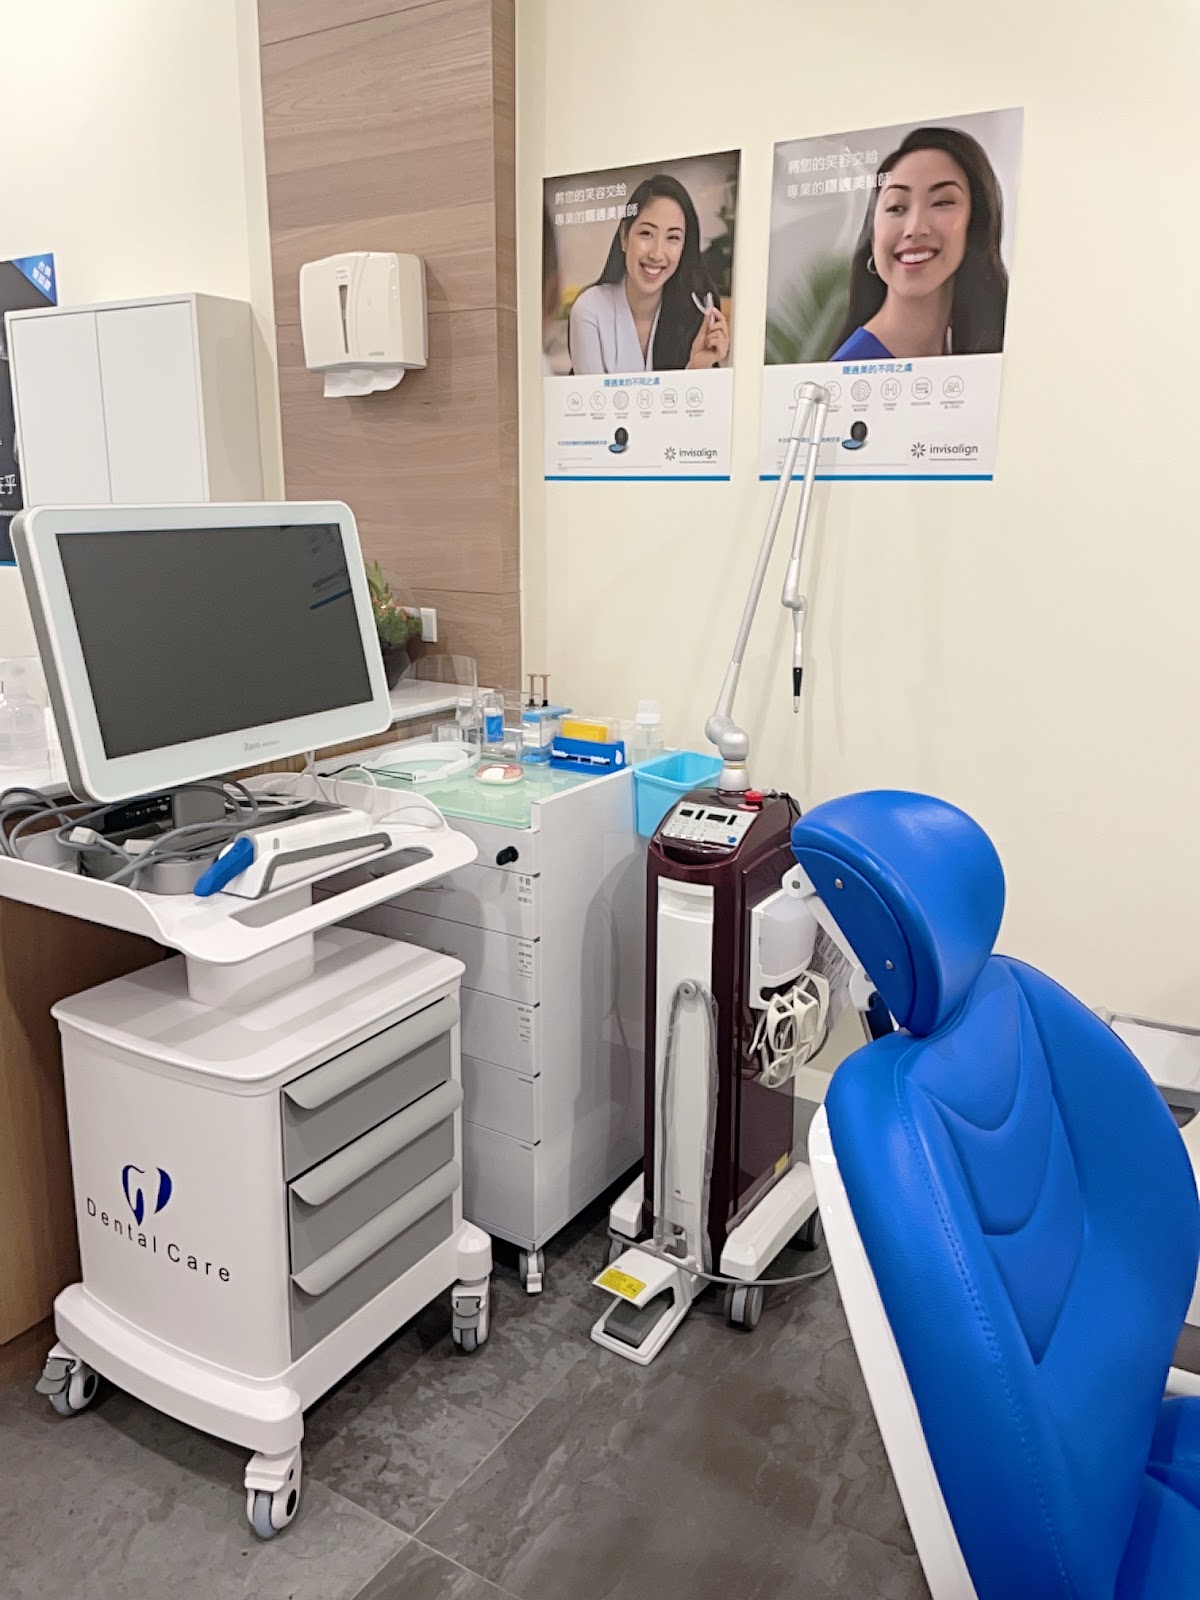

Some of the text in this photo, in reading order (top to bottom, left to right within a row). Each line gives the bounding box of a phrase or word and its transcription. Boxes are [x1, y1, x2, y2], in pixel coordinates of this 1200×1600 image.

[679, 447, 718, 459] invisalign
[929, 443, 979, 456] invisalign
[86, 1196, 230, 1282] Dental Care
